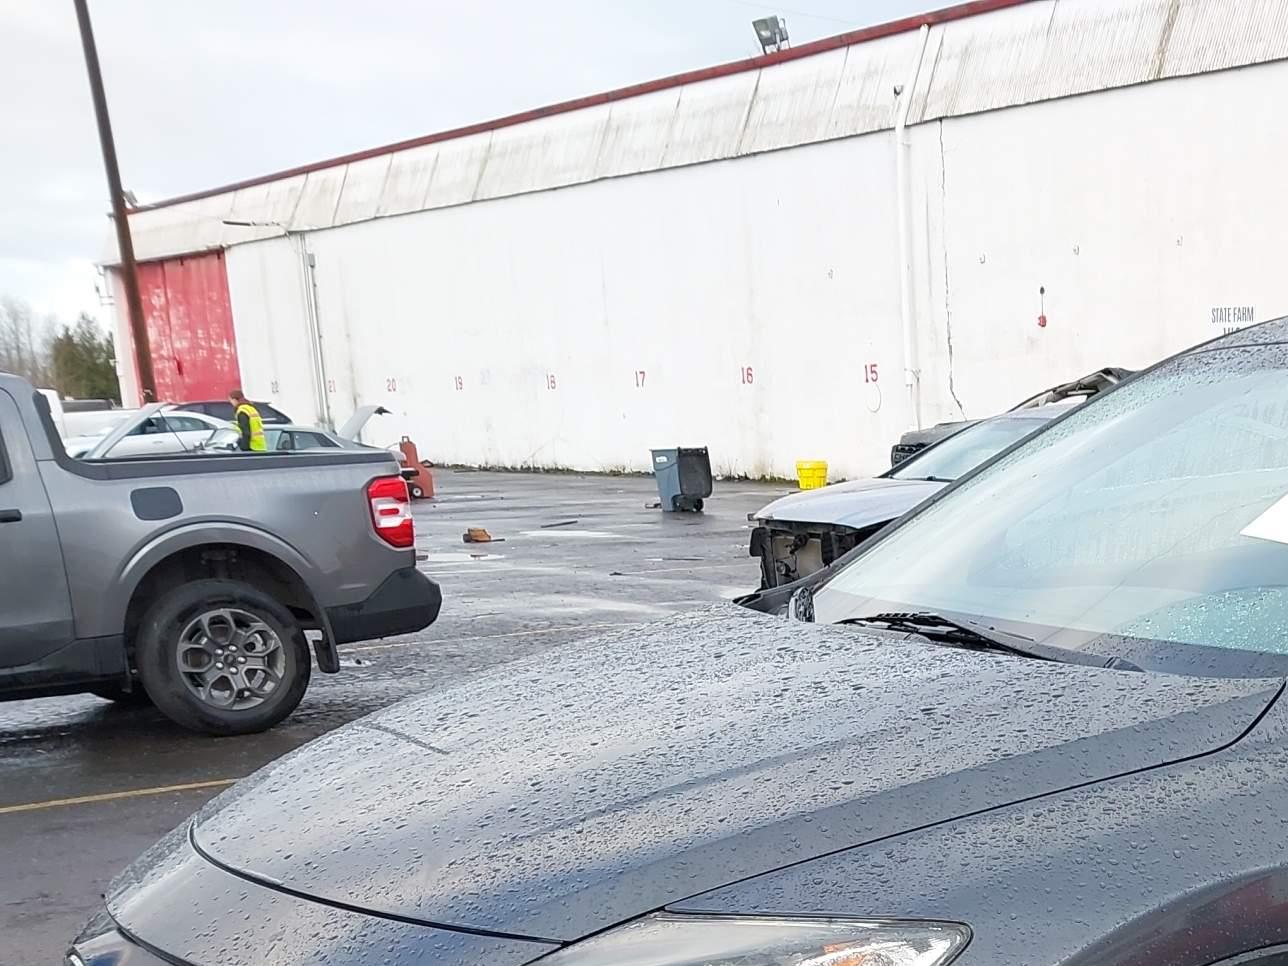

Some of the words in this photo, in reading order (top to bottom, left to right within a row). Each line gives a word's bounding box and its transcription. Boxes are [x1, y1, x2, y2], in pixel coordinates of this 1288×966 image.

[1211, 307, 1231, 323] STATE
[1233, 306, 1254, 322] FARM
[546, 374, 556, 389] 18
[635, 371, 646, 388] 17
[741, 366, 753, 384] 16
[864, 364, 878, 383] 15
[386, 378, 396, 392] 20
[454, 376, 463, 390] 19
